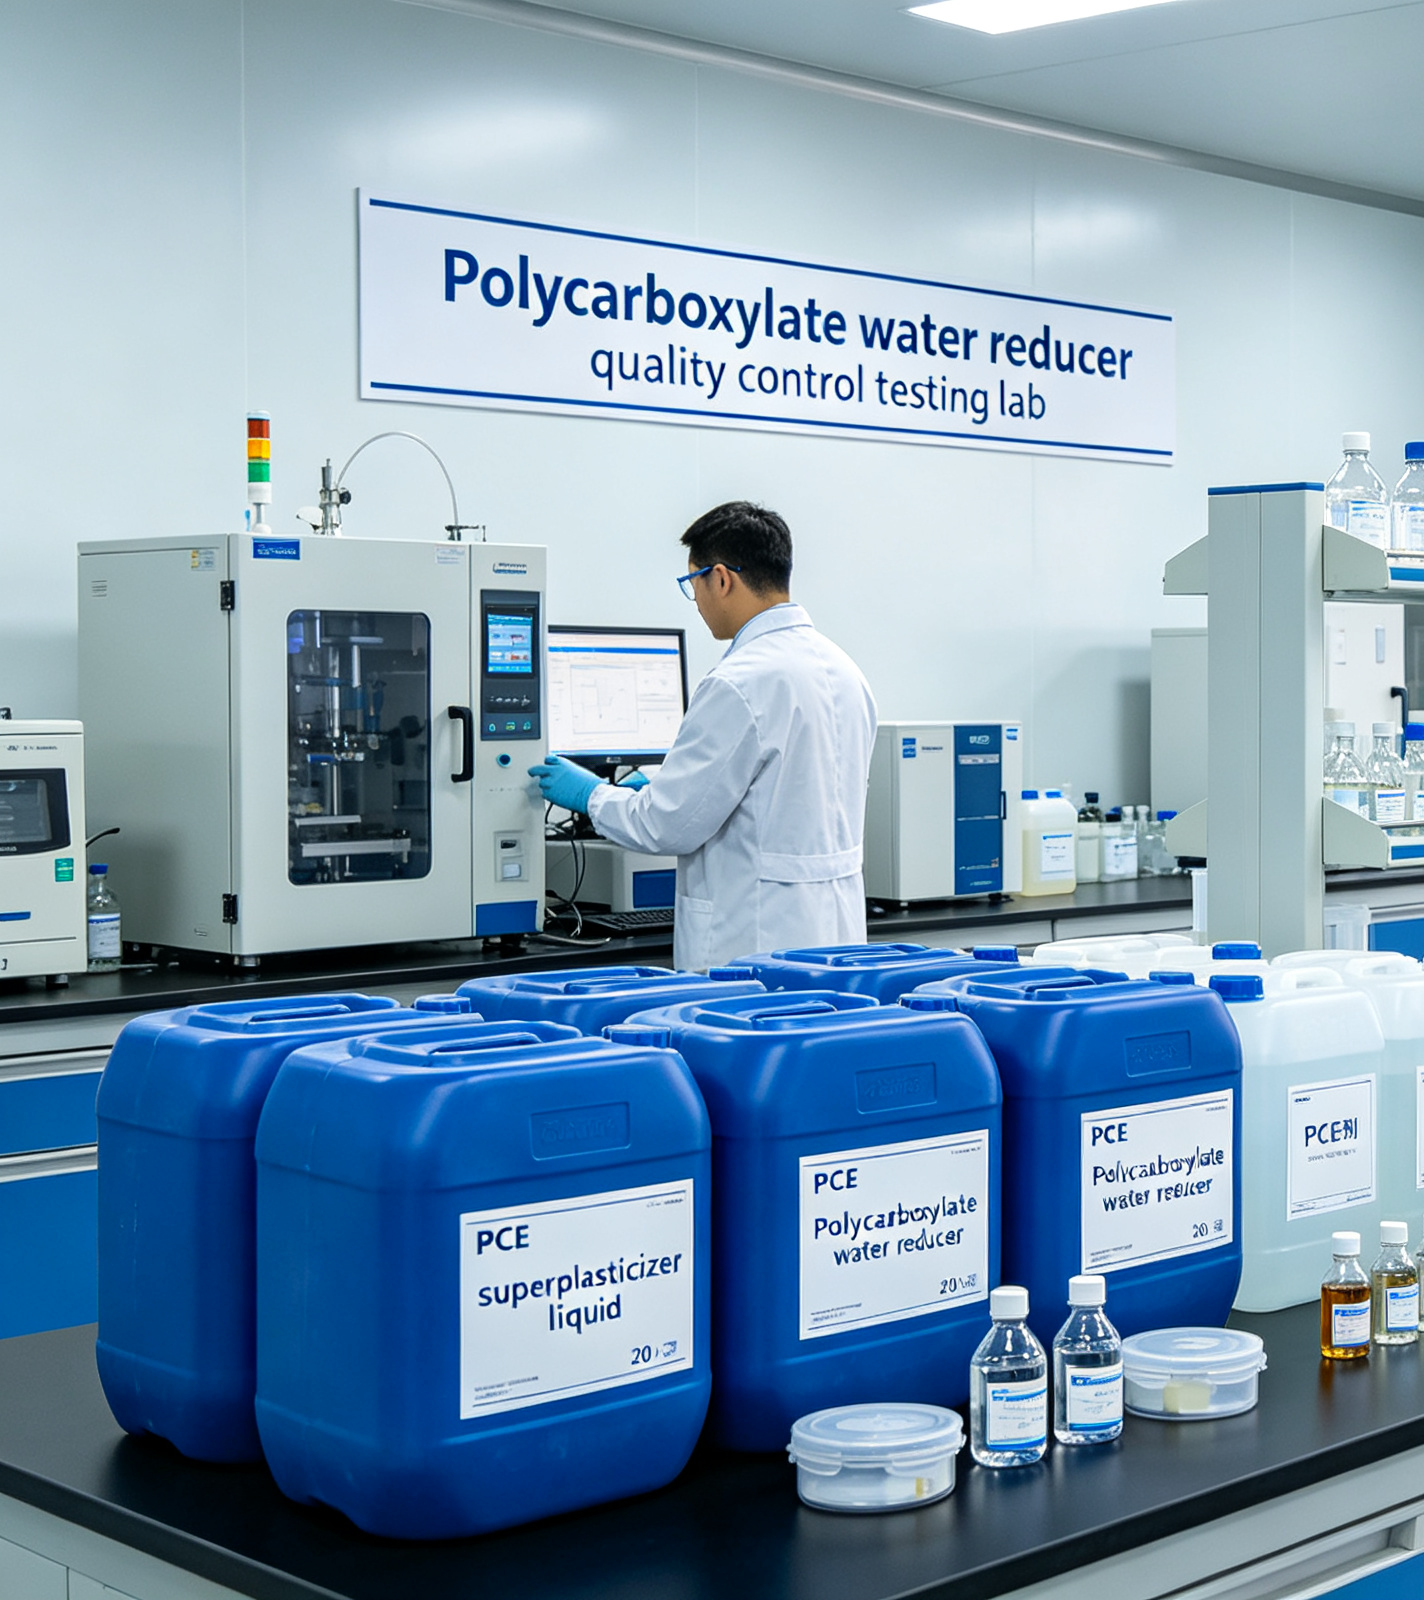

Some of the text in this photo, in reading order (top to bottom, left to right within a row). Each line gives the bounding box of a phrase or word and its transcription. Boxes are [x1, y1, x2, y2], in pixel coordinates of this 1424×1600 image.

[444, 248, 1133, 380] Polycarboxylate water reducer
[590, 346, 1047, 425] quality control testing lab
[1091, 1122, 1128, 1147] PCE
[814, 1167, 858, 1194] PCE
[476, 1225, 530, 1255] PCE
[833, 1227, 965, 1266] water reducer
[478, 1252, 683, 1309] superplasticizer
[549, 1293, 622, 1335] liquid
[631, 1344, 652, 1366] 20
